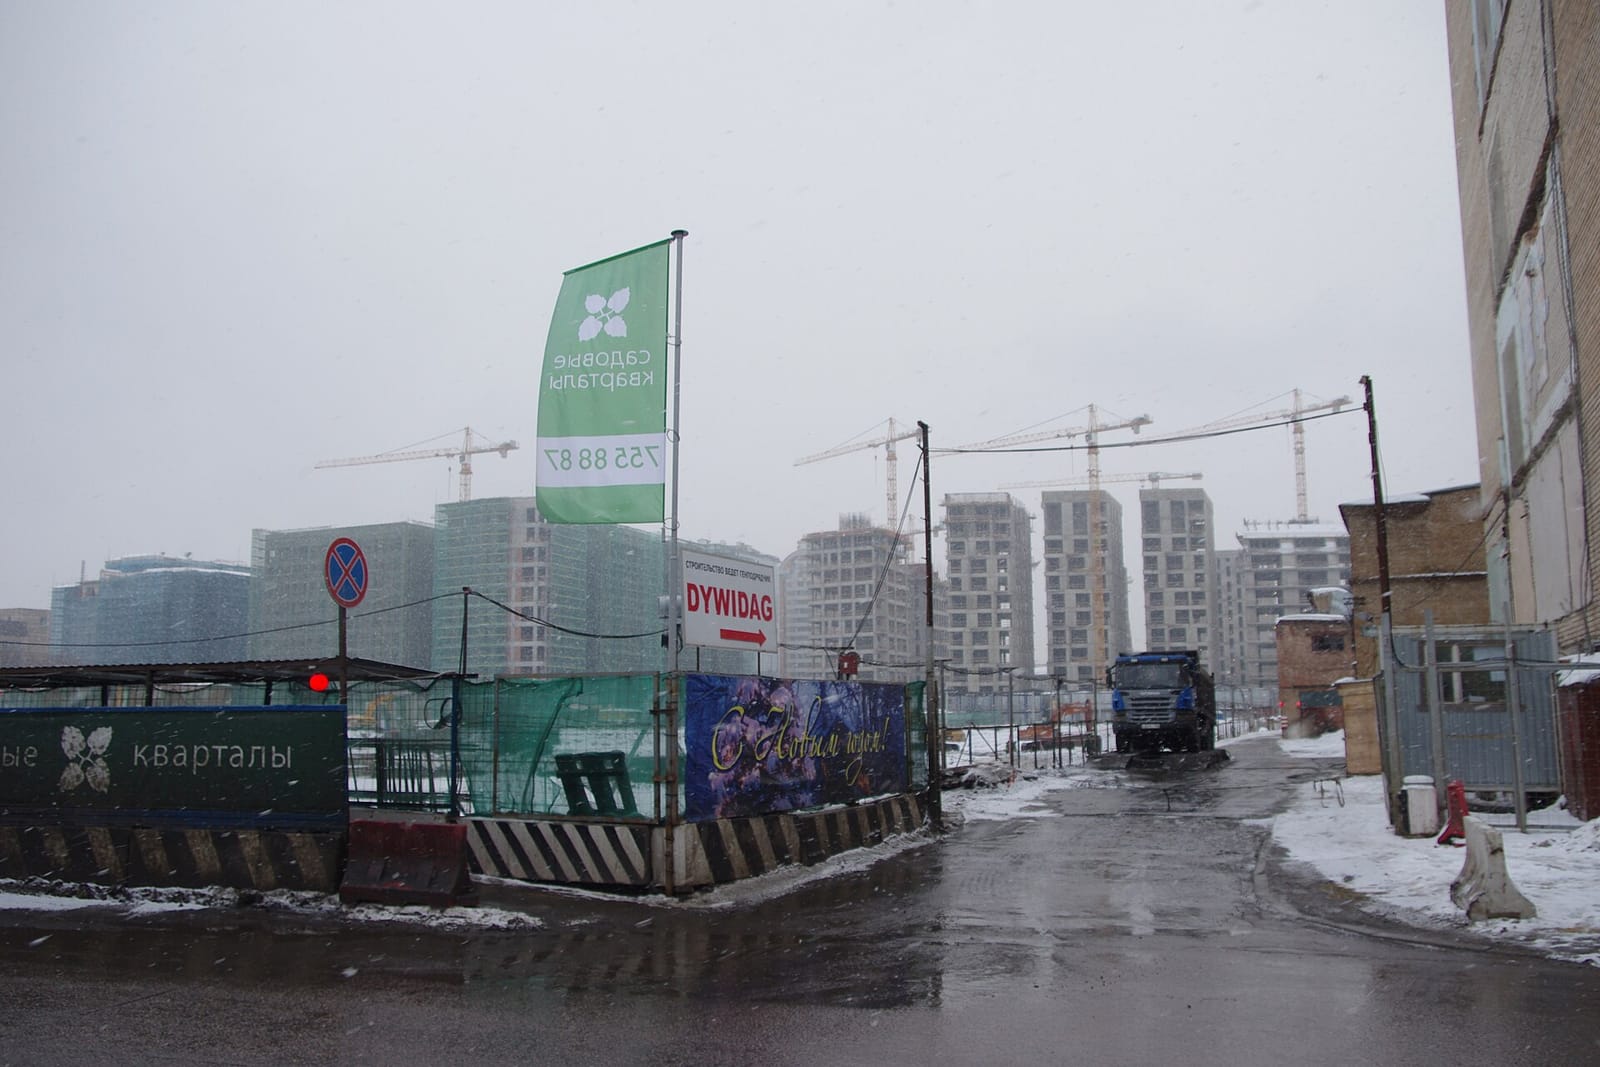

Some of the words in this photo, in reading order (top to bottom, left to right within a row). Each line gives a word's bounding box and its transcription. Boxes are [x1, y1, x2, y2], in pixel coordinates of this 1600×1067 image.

[685, 560, 724, 575] СТРОИТЕЛЬСТВО
[686, 582, 773, 622] DYWIDAG
[711, 705, 745, 771] С
[133, 744, 293, 775] кварталы
